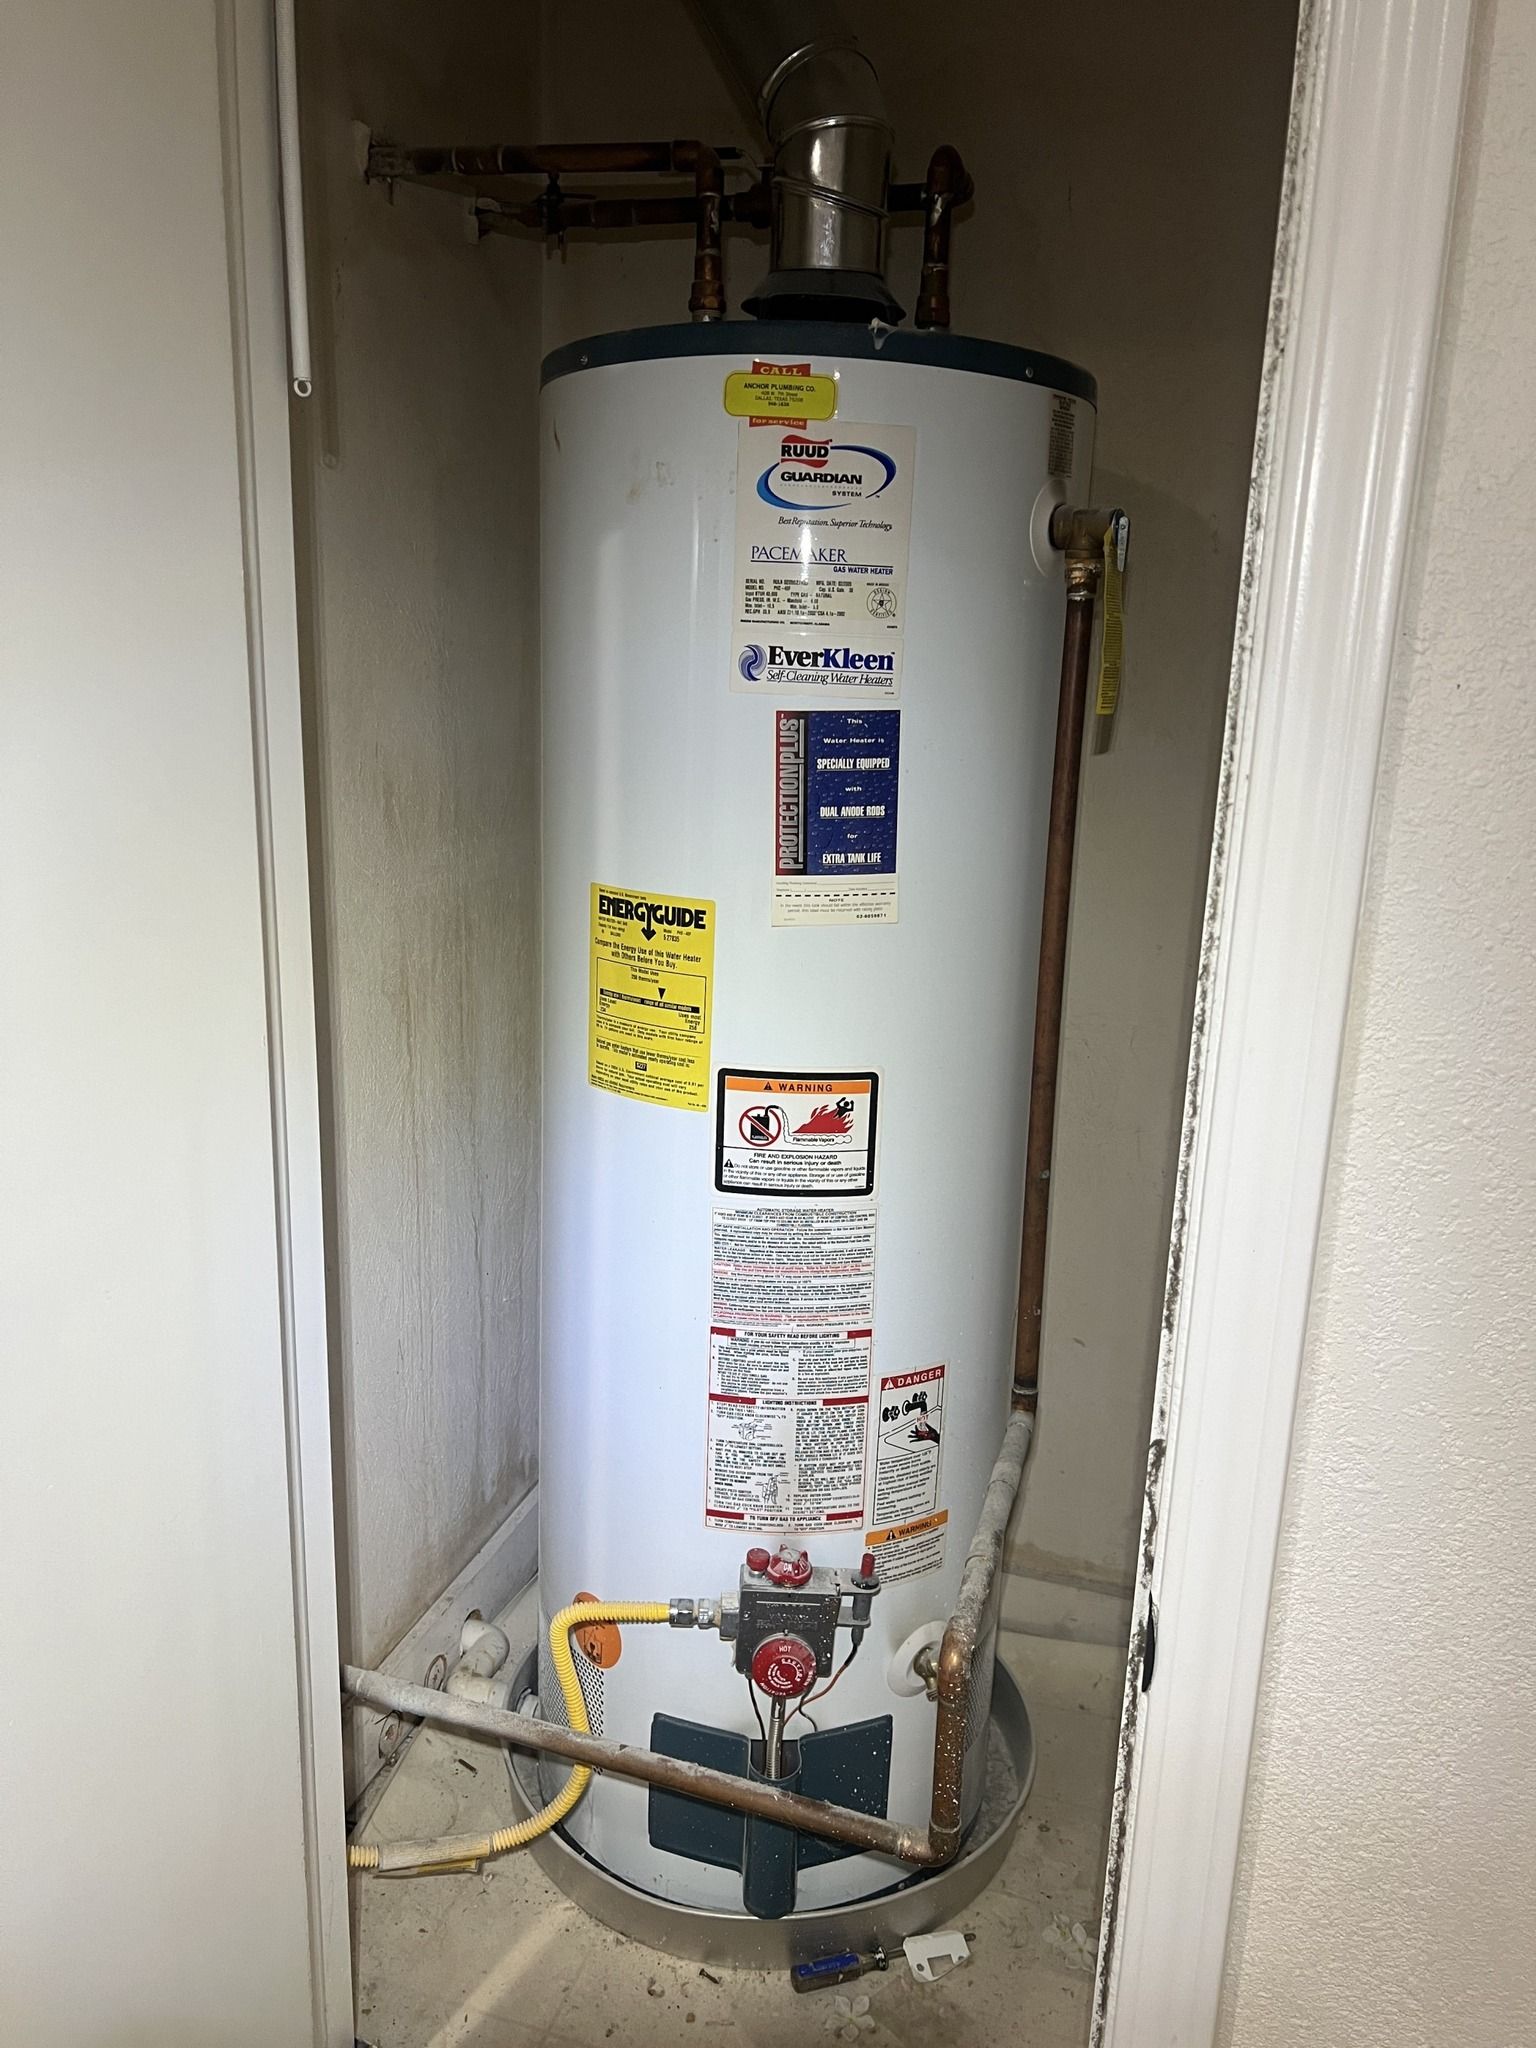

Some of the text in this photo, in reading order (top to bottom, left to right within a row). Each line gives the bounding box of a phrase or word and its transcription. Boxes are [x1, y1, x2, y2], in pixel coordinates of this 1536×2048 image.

[760, 366, 802, 375] CALL
[781, 445, 829, 458] RUUD
[781, 472, 862, 484] GUARDIAN
[778, 517, 791, 525] Best
[830, 519, 858, 529] Superior
[859, 520, 893, 531] Technology
[768, 646, 894, 670] EverKleen
[767, 670, 893, 685] Self-Cleaning Water Heaters
[817, 758, 890, 770] SPECIALLY EQUIPPED
[779, 718, 804, 869] PROTECTIONPLUS
[820, 806, 885, 817] DUAL ANODE RODS
[823, 852, 881, 864] EXTRA TANK LIFE
[599, 894, 706, 930] ENERGYGUIDE
[595, 937, 612, 947] Compare
[621, 943, 636, 953] Energy
[655, 949, 664, 957] this
[683, 954, 701, 962] Heater
[621, 952, 636, 961] Others
[637, 955, 653, 964] Before
[666, 960, 677, 969] Buy.
[779, 1084, 833, 1092] WARNING
[897, 1369, 942, 1387] DANGER
[899, 1521, 932, 1536] WARNING
[781, 1658, 802, 1681] CAUTION
